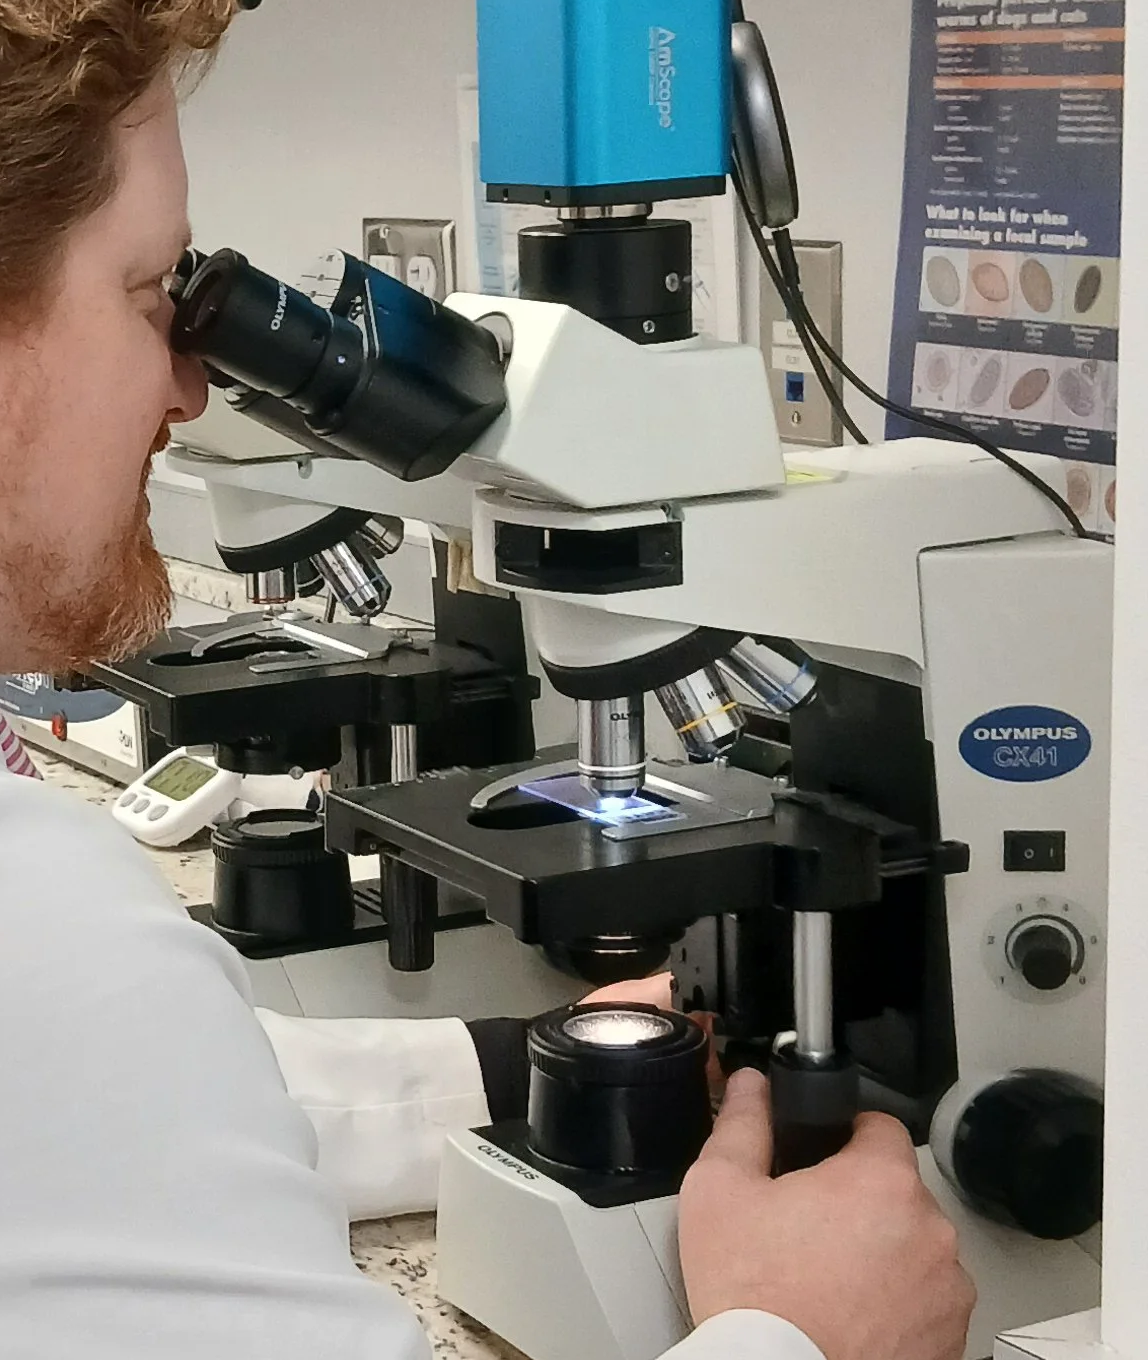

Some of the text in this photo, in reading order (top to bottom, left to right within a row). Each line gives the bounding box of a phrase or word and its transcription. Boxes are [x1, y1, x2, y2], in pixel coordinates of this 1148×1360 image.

[657, 27, 676, 128] AmScope
[925, 203, 1069, 226] What to look for when
[993, 231, 1003, 243] a
[973, 727, 1078, 741] OLYMPUS
[993, 745, 1058, 768] CX41
[477, 1144, 540, 1180] OLYMPUS
